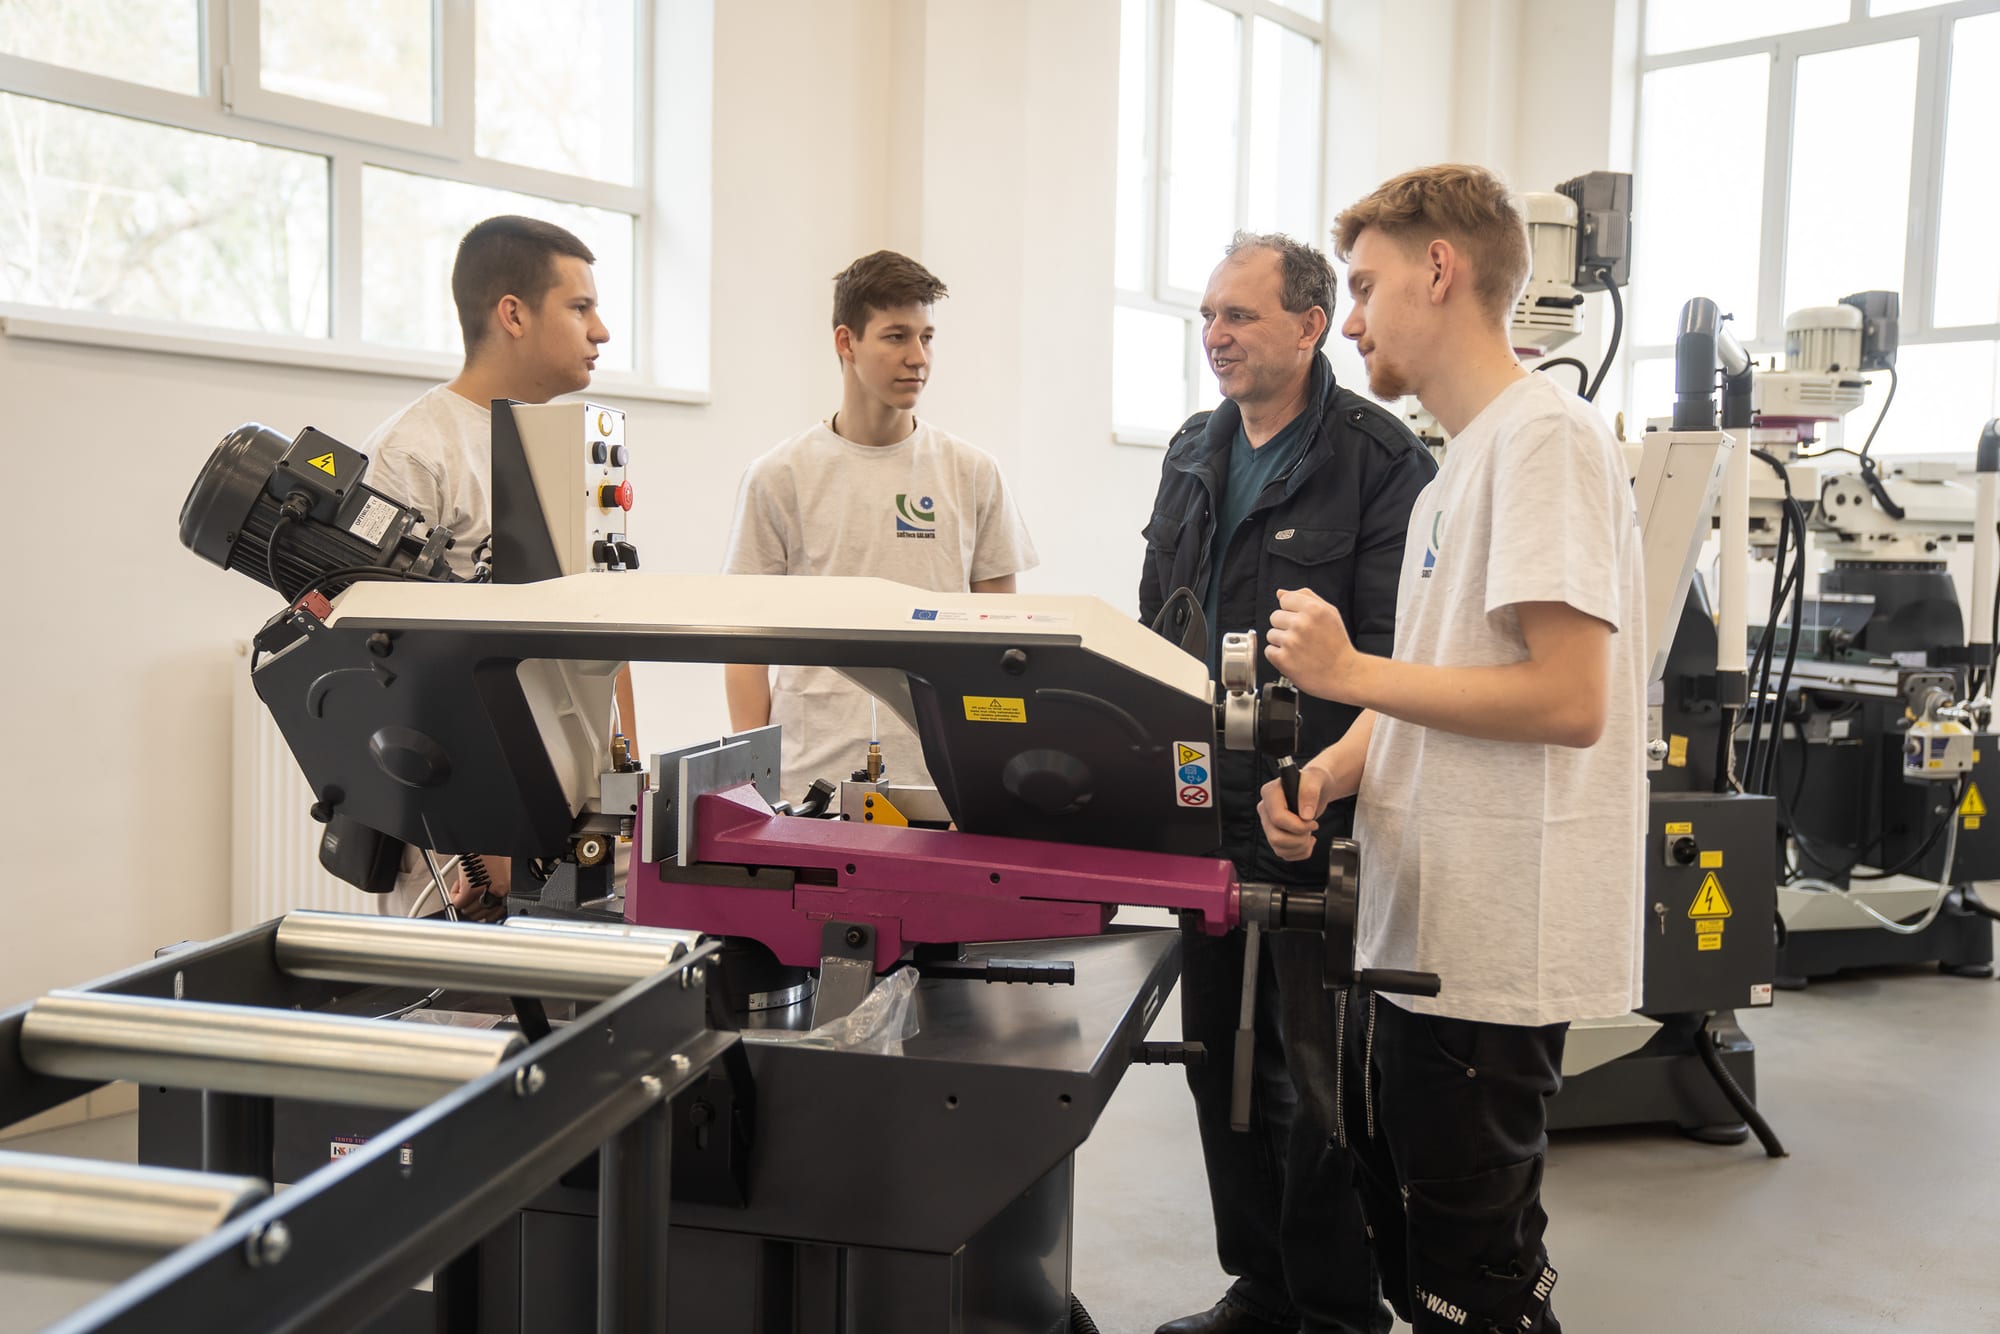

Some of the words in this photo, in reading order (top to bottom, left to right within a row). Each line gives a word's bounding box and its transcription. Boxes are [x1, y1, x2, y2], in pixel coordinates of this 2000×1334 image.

[354, 502, 372, 526] OPTIMUM
[1532, 1266, 1557, 1302] IRIE
[1426, 1293, 1468, 1325] WASH
